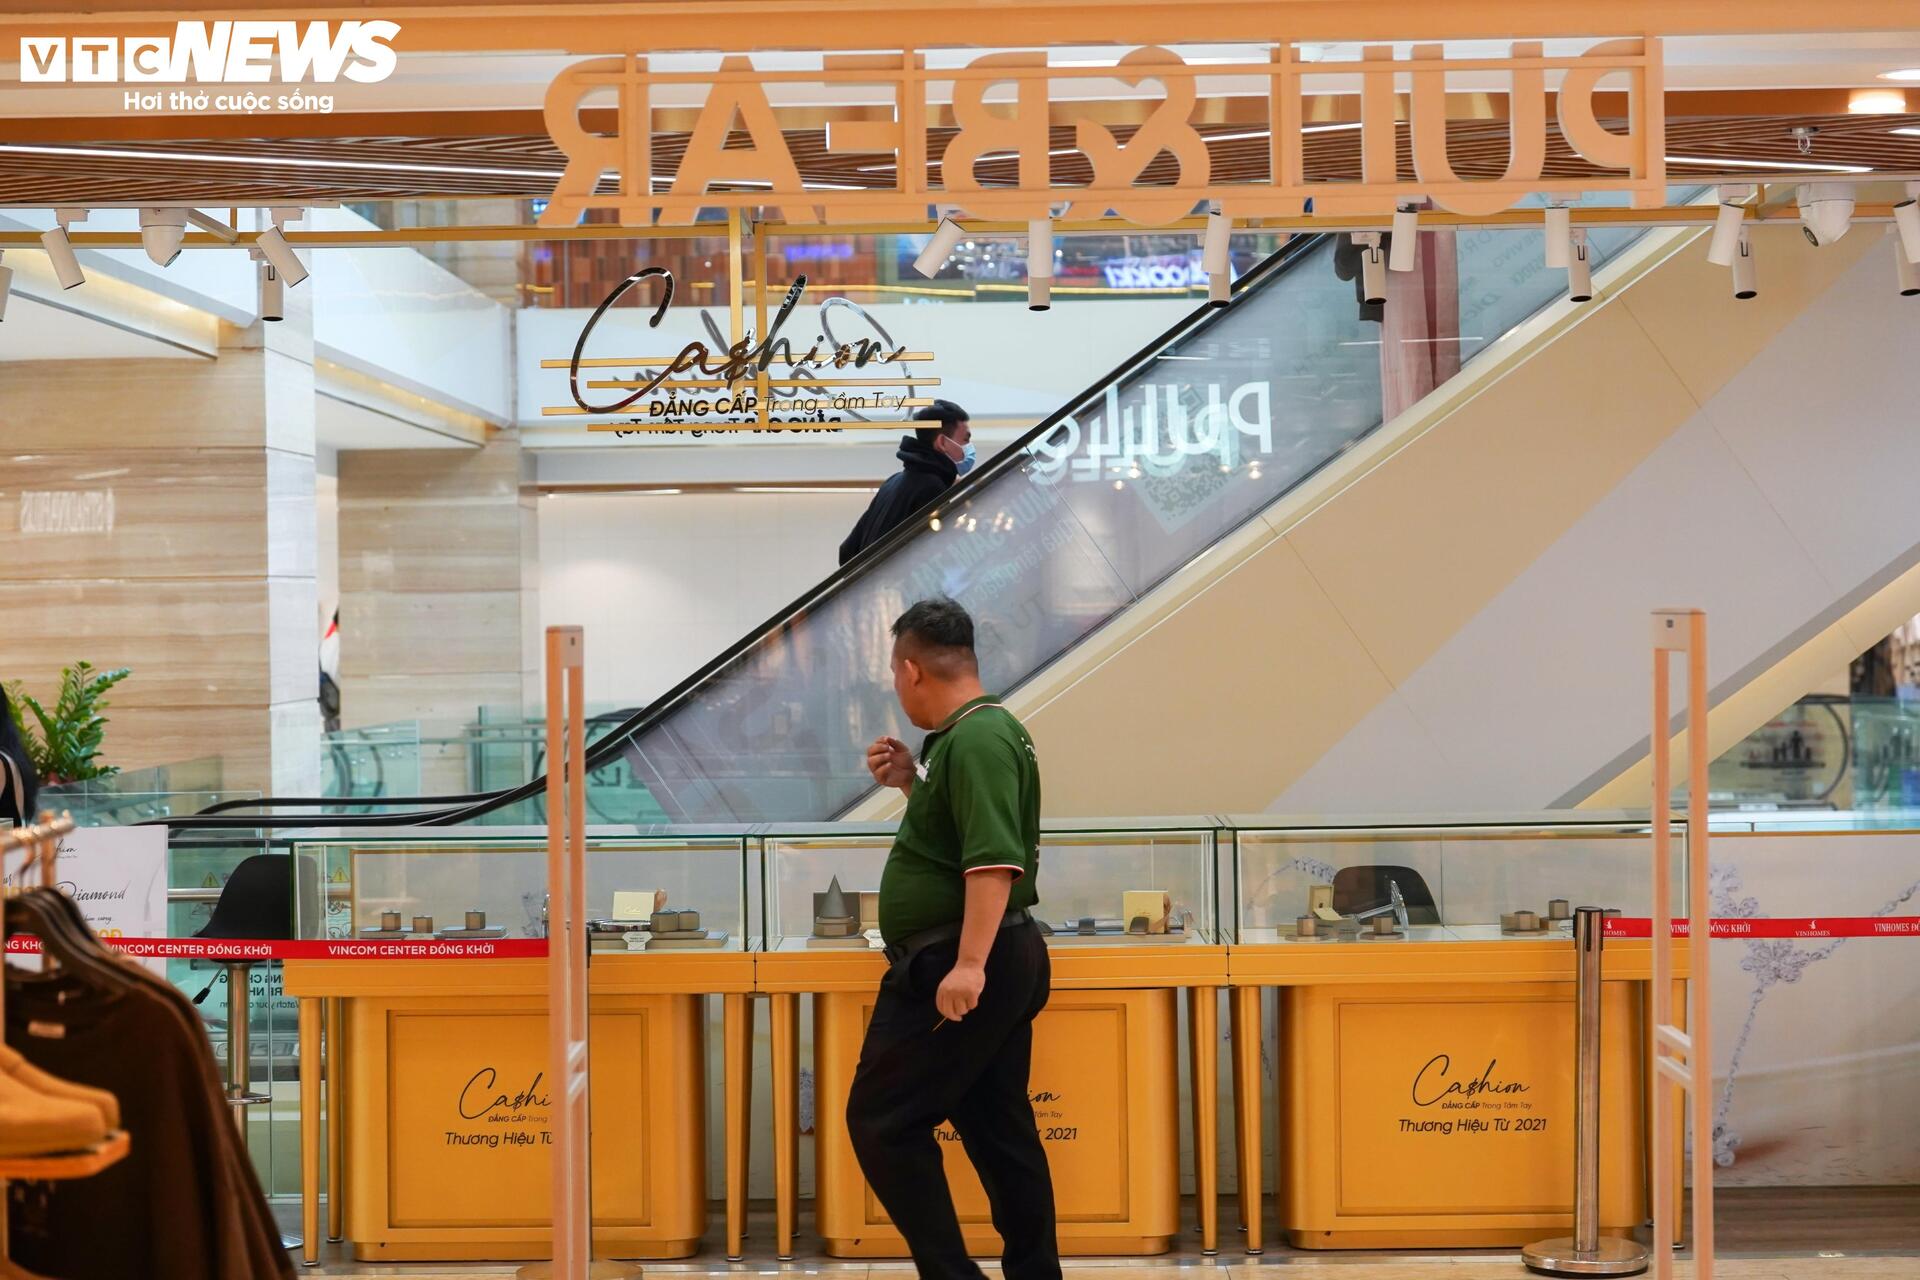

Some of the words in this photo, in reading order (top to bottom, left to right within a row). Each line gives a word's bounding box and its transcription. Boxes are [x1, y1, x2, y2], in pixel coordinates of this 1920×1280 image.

[649, 391, 709, 417] ĐẲNG
[715, 390, 757, 415] CẤP
[764, 395, 818, 415] Trong
[1874, 922, 1910, 933] VINHOMES
[158, 945, 204, 955] CENTER
[328, 945, 377, 956] VINCOM
[379, 945, 427, 955] CENTER
[1399, 1118, 1453, 1135] Thương
[1456, 1118, 1489, 1134] Hiệu
[1493, 1117, 1511, 1131] Từ
[1514, 1118, 1547, 1131] 2021
[445, 1131, 499, 1148] Thương
[503, 1132, 535, 1147] Hiệu
[1045, 1127, 1077, 1140] 2021
